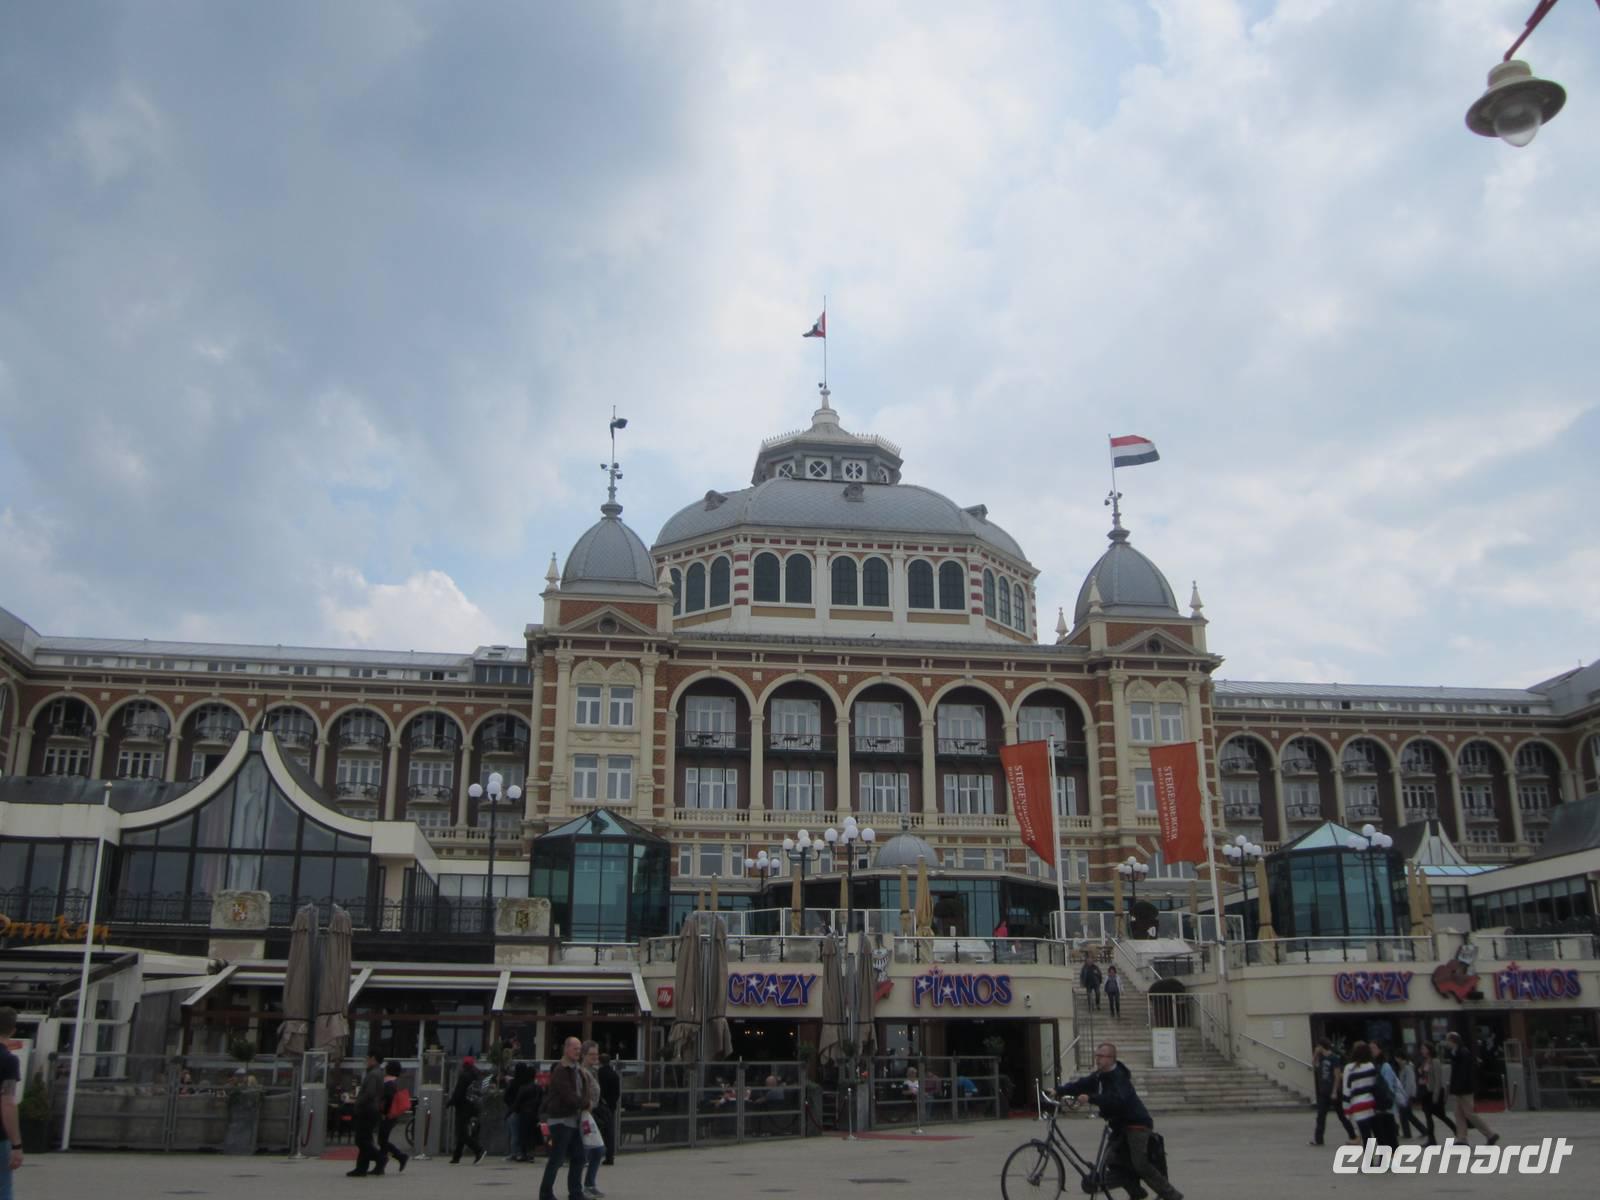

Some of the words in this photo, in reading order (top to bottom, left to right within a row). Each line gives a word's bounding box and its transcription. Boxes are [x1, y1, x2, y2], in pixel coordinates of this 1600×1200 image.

[1014, 765, 1036, 841] STEIGEN
[1163, 766, 1179, 840] STEIGENBERGER
[727, 973, 817, 1008] CRAZY
[913, 966, 1013, 1008] PIANOS
[1335, 971, 1414, 1003] CRAZY
[1495, 962, 1582, 1001] PIANOS
